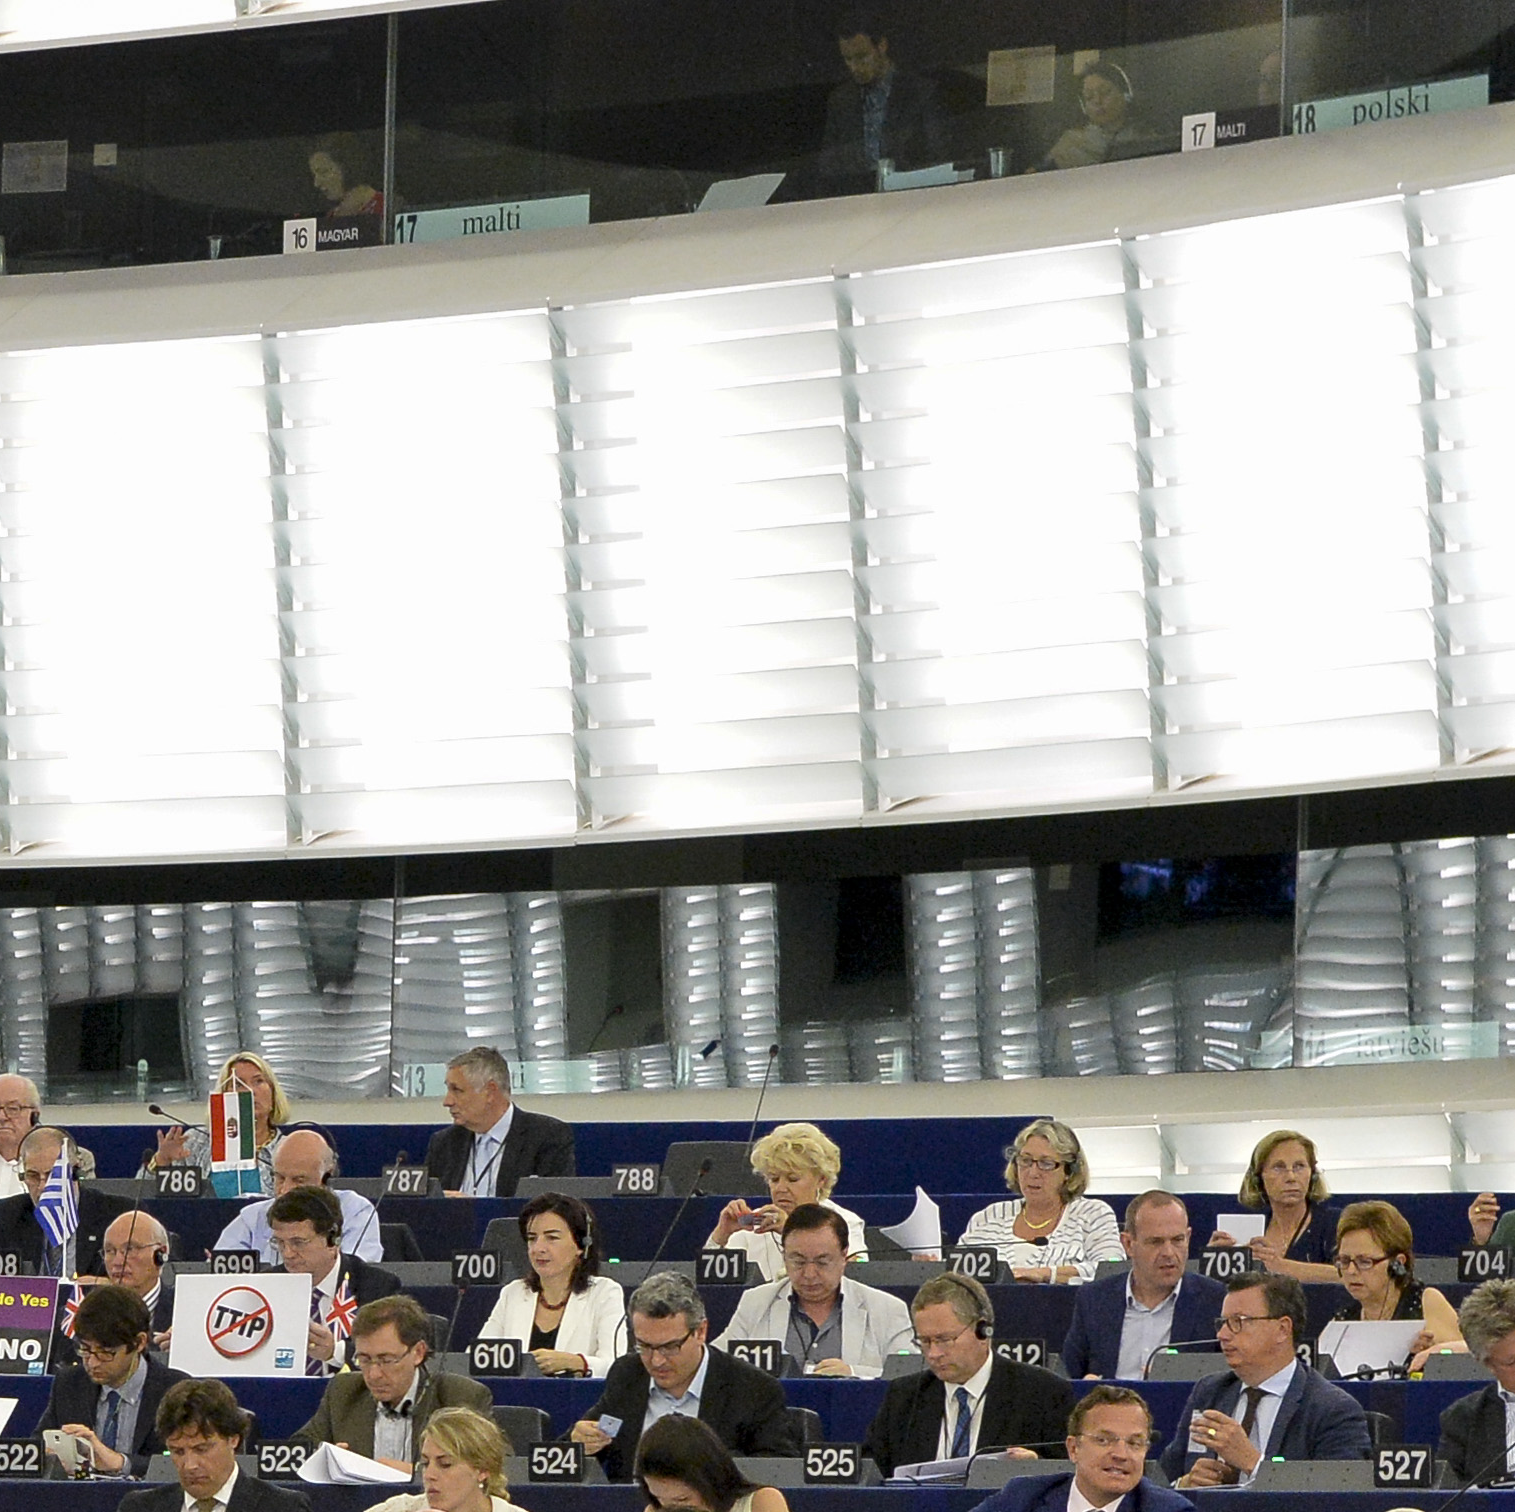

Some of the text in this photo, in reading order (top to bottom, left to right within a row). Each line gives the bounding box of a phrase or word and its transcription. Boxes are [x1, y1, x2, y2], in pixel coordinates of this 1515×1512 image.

[1294, 84, 1430, 135] 18 polski
[1190, 122, 1246, 147] 17 MALTI
[395, 204, 521, 244] 17 malti
[290, 226, 359, 250] 16 MAGYAR
[403, 1066, 426, 1097] 13
[158, 1171, 196, 1192] 786
[386, 1170, 423, 1192] 787
[615, 1169, 655, 1191] 788
[213, 1254, 254, 1274] 699
[456, 1253, 496, 1277] 700
[702, 1253, 740, 1278] 701
[949, 1252, 992, 1277] 702
[1202, 1251, 1245, 1276] 703
[1461, 1250, 1505, 1276] 704
[19, 1294, 50, 1309] Yes
[213, 1305, 266, 1338] TTIP
[475, 1343, 515, 1368] 610
[734, 1344, 773, 1370] 611
[259, 1445, 306, 1473] 523
[531, 1447, 577, 1475] 524
[807, 1449, 855, 1477] 525
[1379, 1449, 1427, 1481] 527
